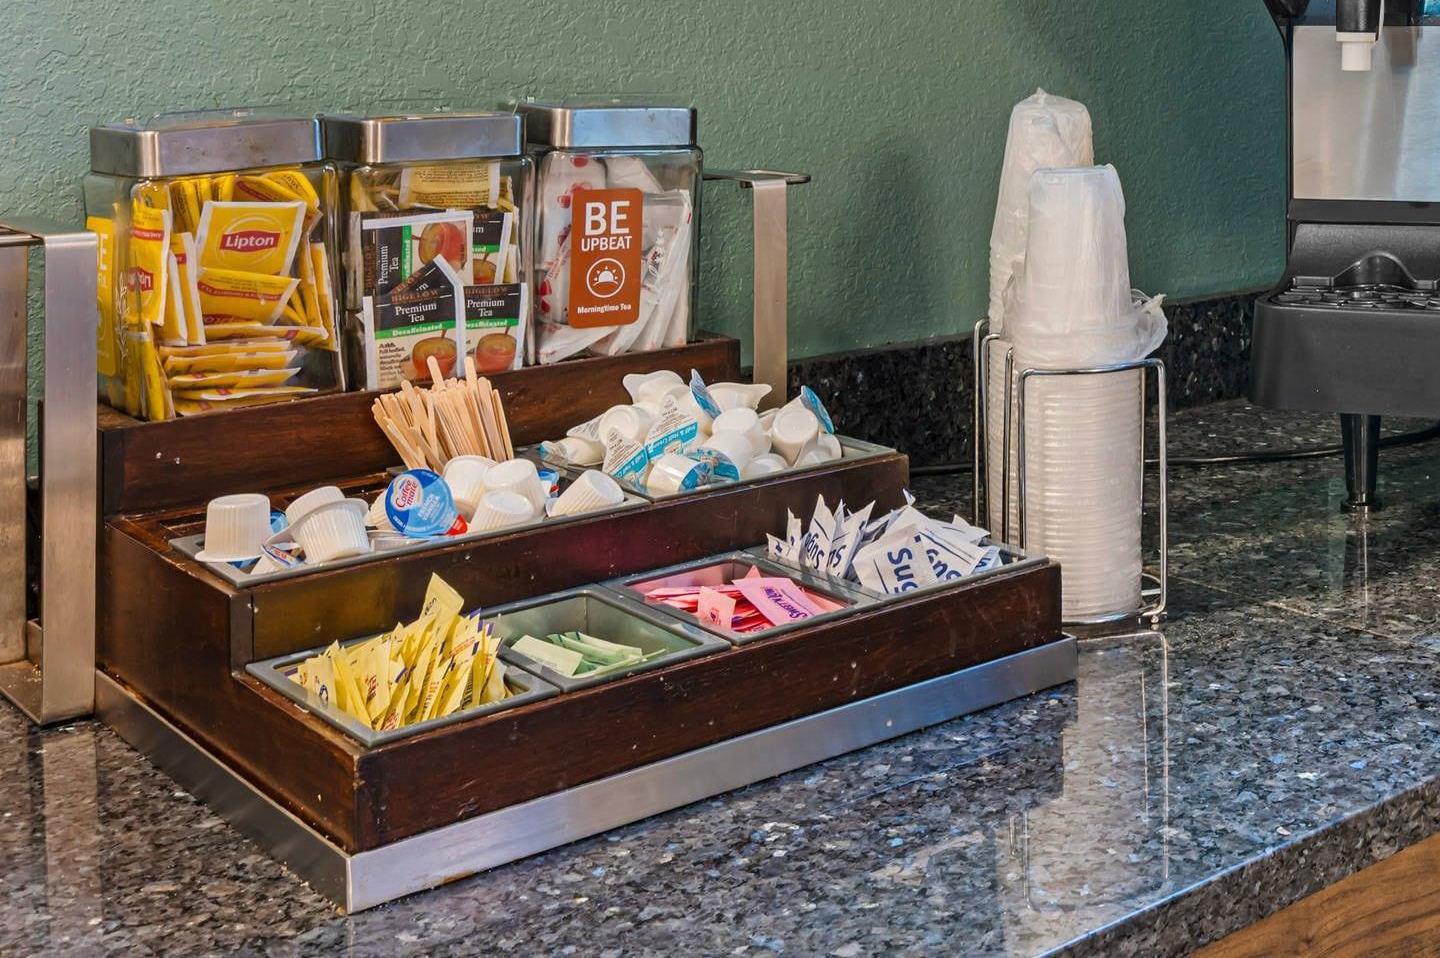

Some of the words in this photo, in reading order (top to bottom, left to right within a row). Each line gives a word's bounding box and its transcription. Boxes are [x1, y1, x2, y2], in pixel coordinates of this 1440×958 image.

[585, 201, 630, 236] BE
[224, 235, 274, 250] Lipton
[581, 235, 632, 252] UPBEAT
[378, 245, 389, 285] Premium
[389, 256, 399, 273] Tea
[395, 302, 437, 316] Premium
[467, 299, 505, 308] Premium
[577, 304, 618, 315] Morningtime
[620, 303, 631, 311] Tea
[408, 314, 425, 323] Tea
[478, 308, 493, 317] Tea
[392, 323, 443, 337] Decaffeinated
[396, 480, 412, 508] Coffee
[406, 482, 418, 505] mate
